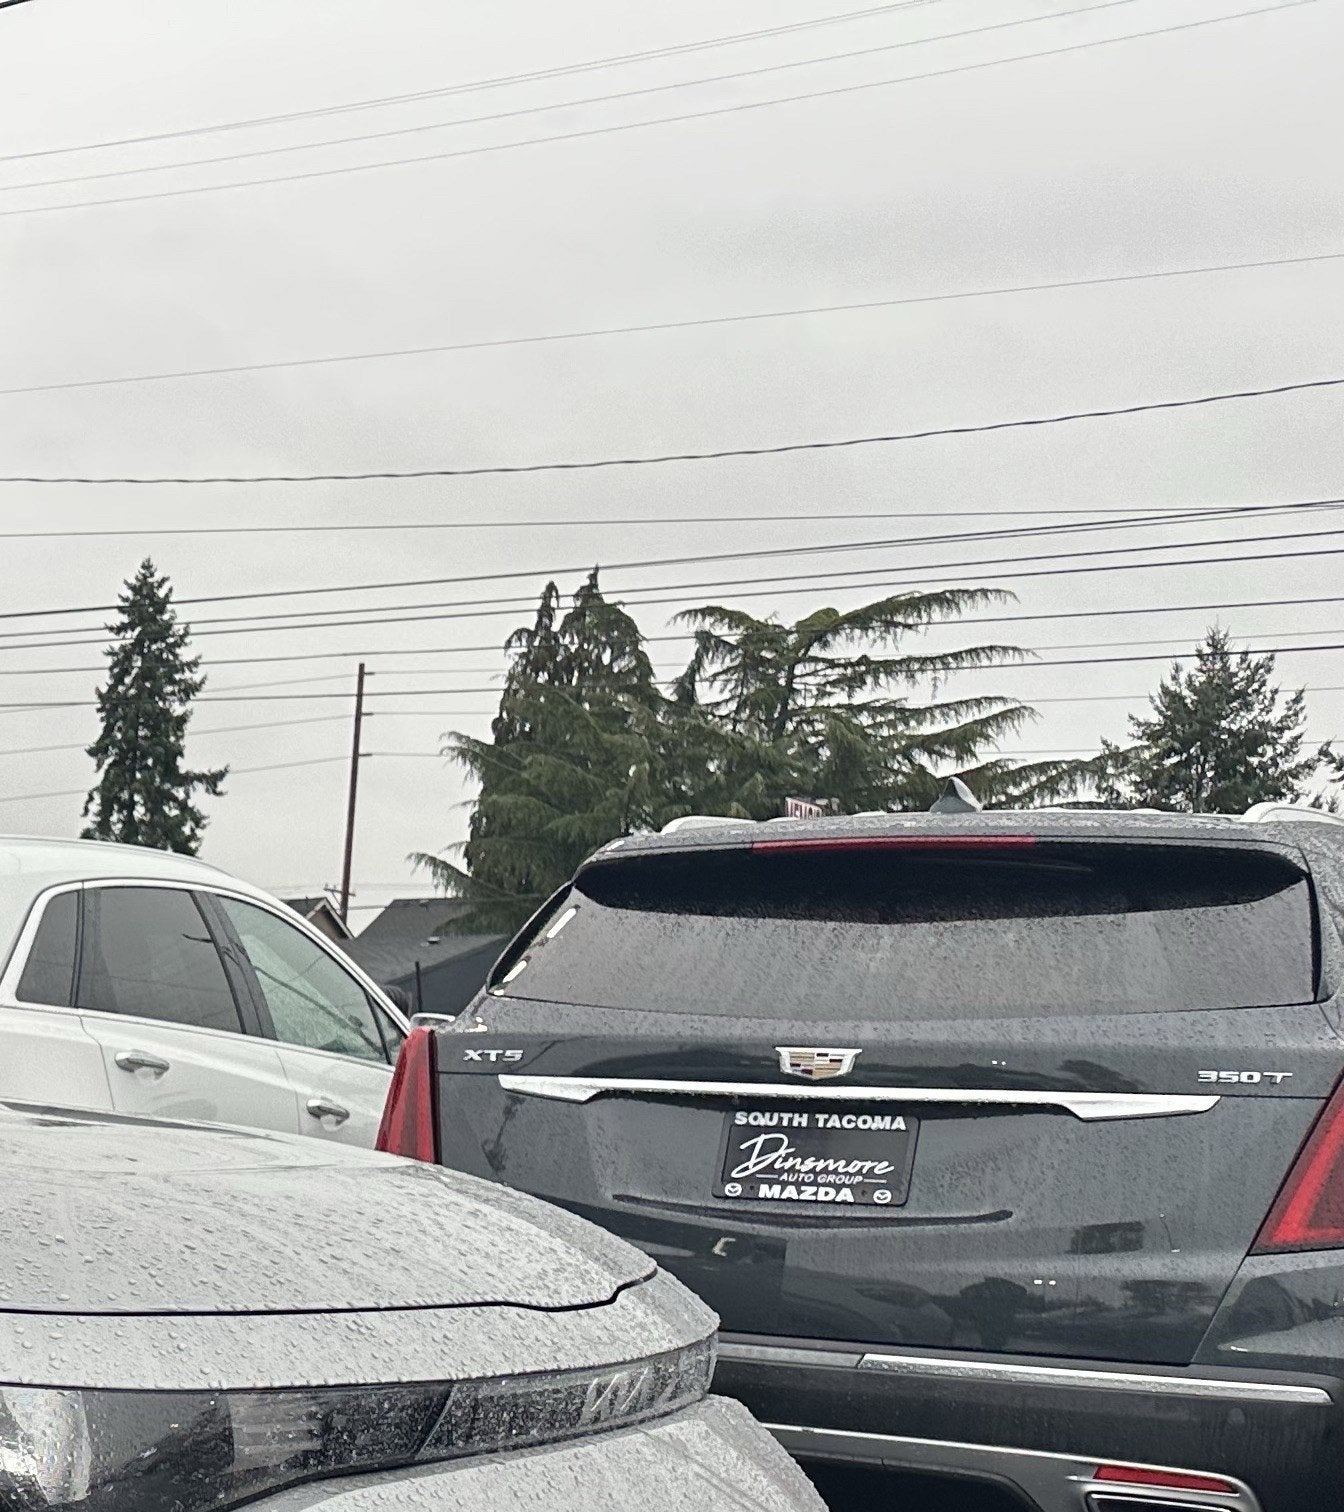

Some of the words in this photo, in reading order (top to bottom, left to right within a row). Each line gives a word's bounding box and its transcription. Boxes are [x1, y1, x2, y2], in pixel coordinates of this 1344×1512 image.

[462, 1049, 524, 1062] XT5
[1197, 1070, 1294, 1084] 350T
[734, 1111, 809, 1128] SOUTH
[815, 1113, 907, 1131] TACOMA
[730, 1133, 895, 1179] Dinsmore
[779, 1172, 815, 1183] AUTO
[817, 1173, 864, 1185] GROUP
[758, 1183, 855, 1203] MAZDA
